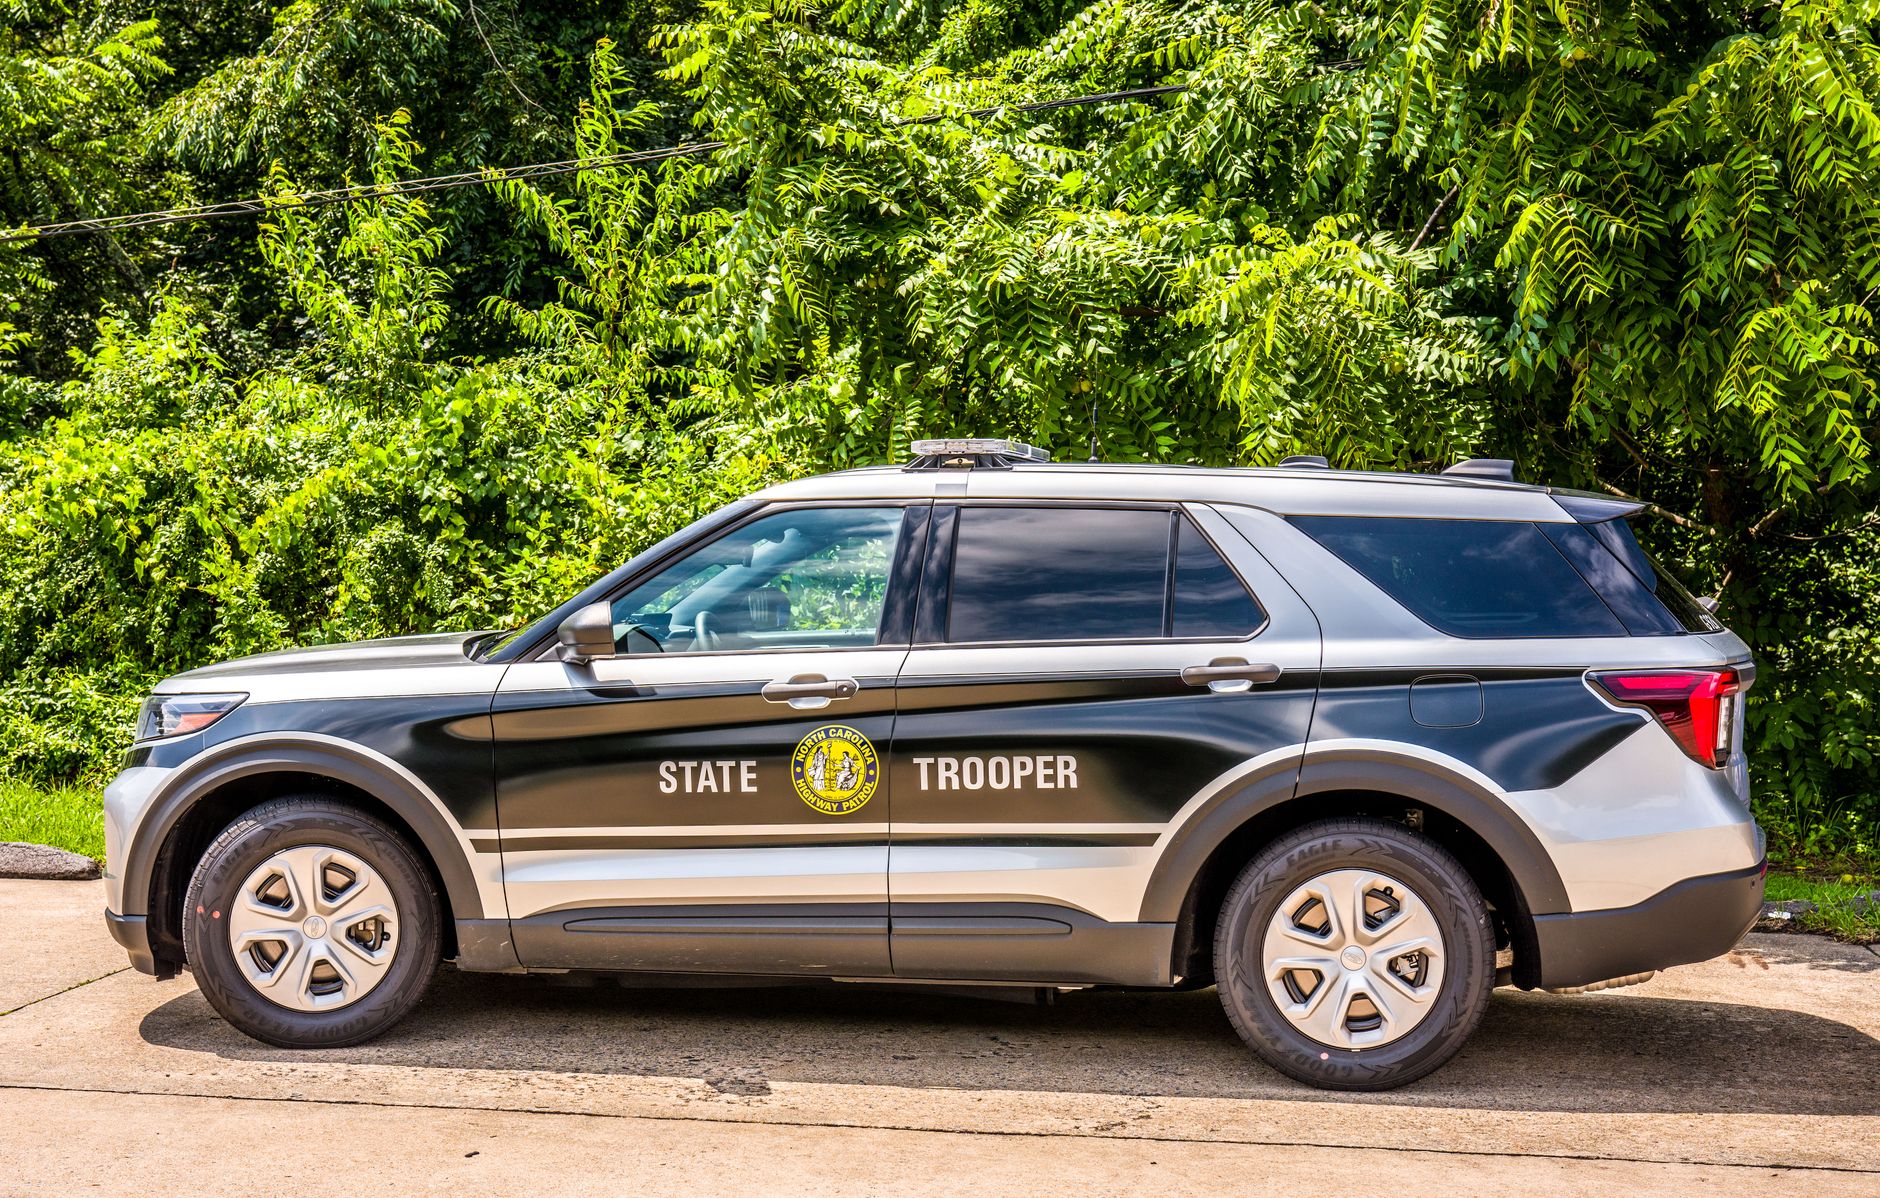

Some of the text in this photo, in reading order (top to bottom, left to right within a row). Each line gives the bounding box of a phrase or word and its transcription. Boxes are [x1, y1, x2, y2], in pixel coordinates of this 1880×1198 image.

[796, 729, 875, 765] NORTH CAROLINA
[659, 755, 1078, 794] STATE TROOPER
[796, 778, 874, 811] HIGHWAY PATROL
[1286, 839, 1343, 868] EAGLE
